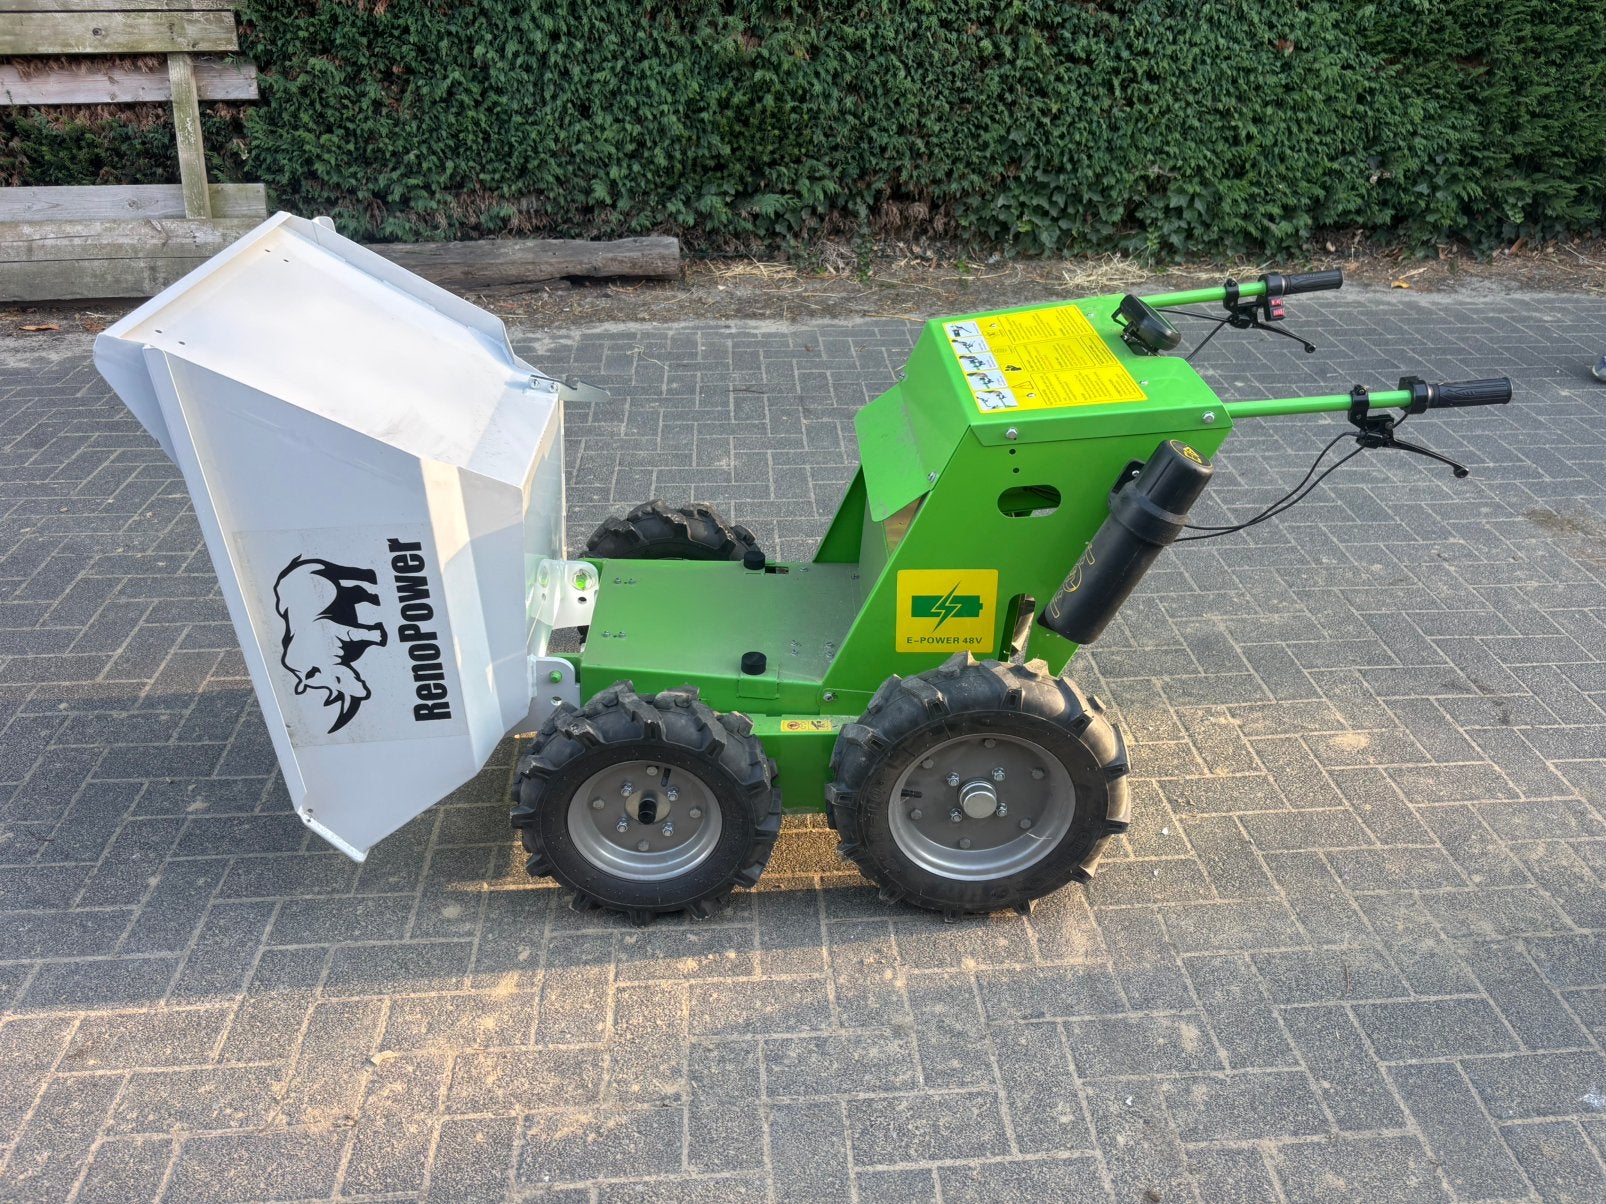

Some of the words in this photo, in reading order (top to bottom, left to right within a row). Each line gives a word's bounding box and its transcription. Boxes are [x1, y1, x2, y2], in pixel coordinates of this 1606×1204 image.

[387, 538, 452, 721] RenoPower
[906, 636, 960, 645] E-POWER
[962, 636, 983, 645] 48V
